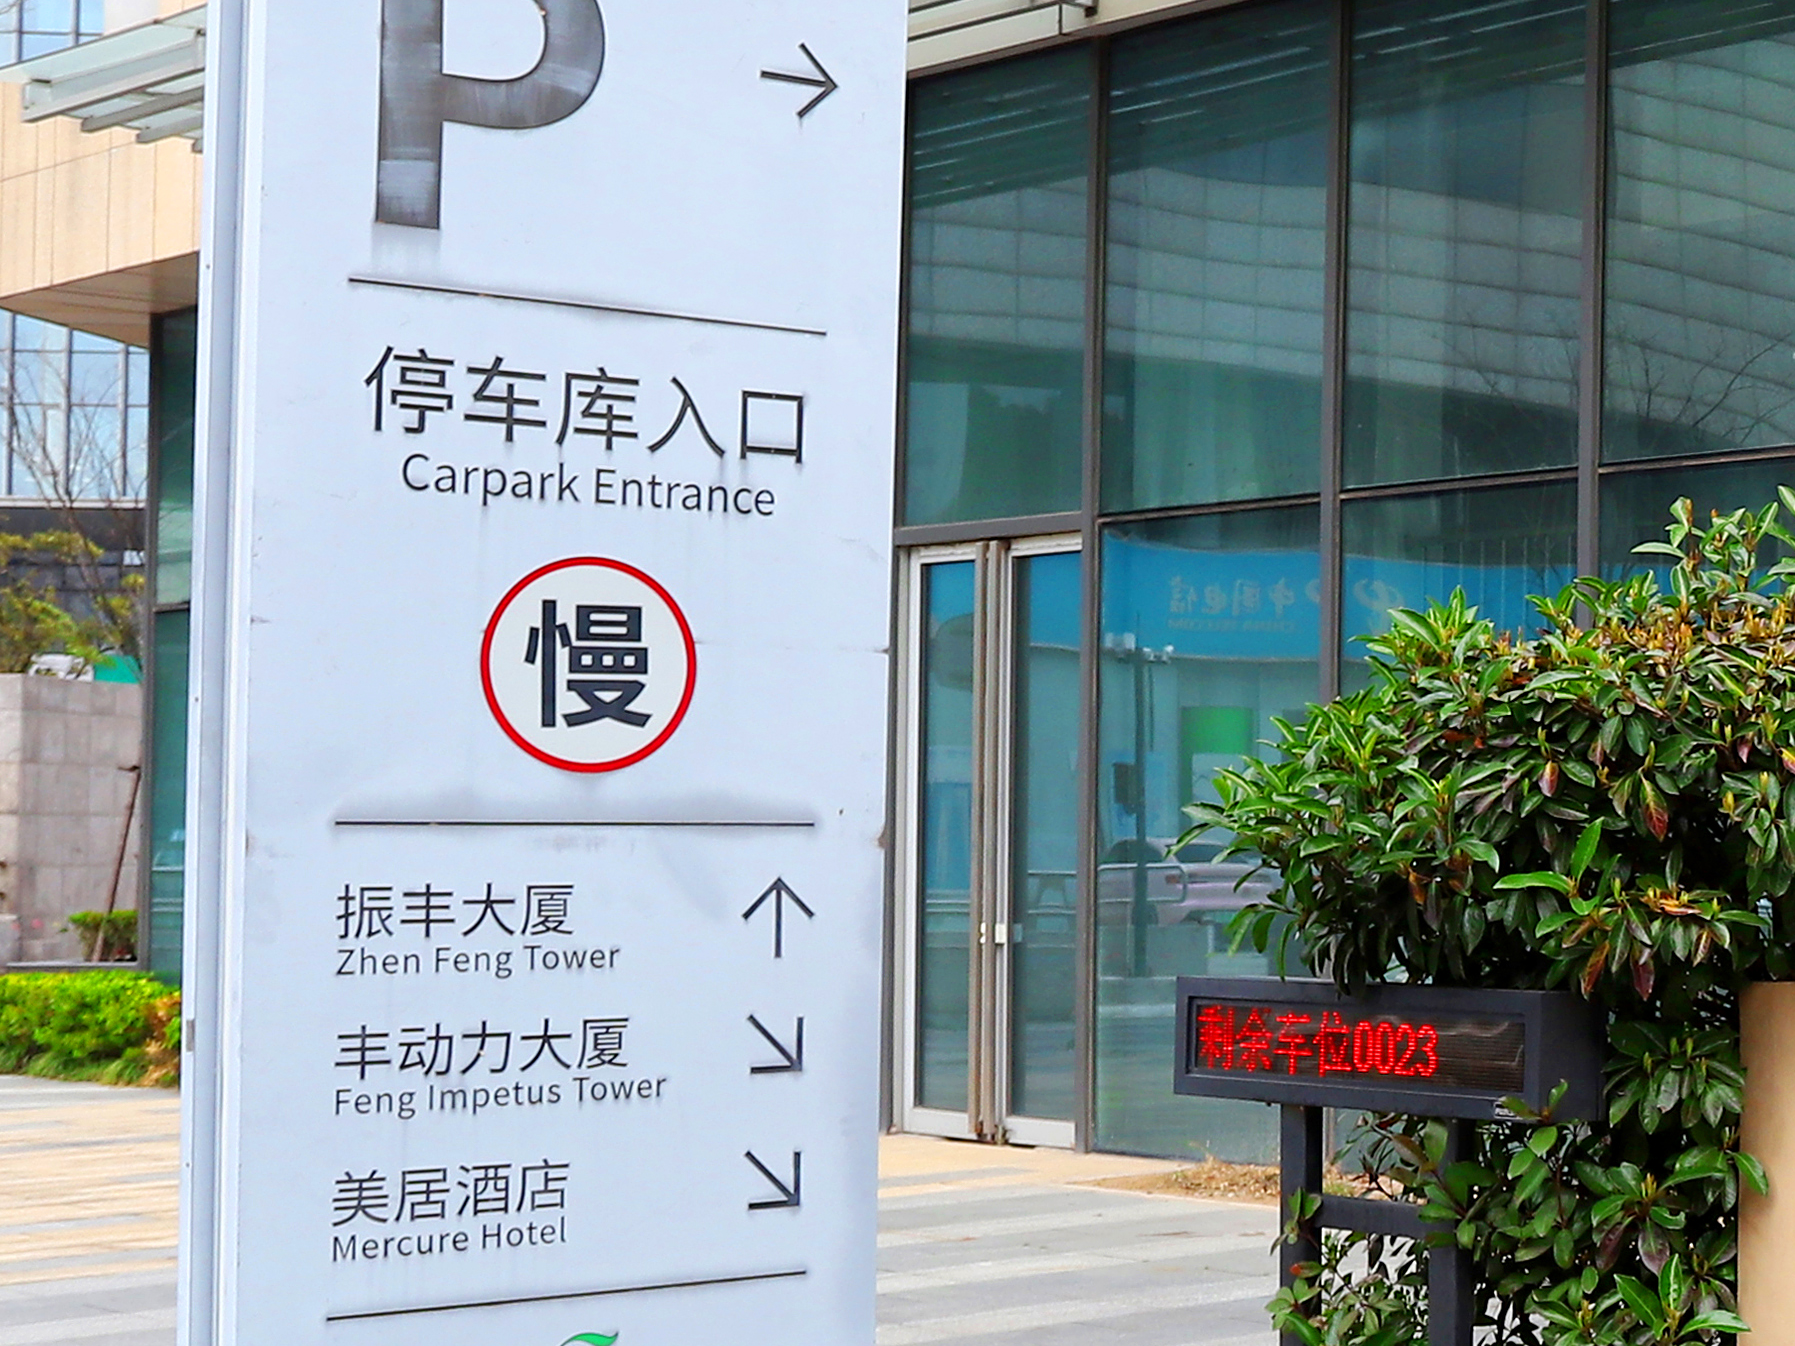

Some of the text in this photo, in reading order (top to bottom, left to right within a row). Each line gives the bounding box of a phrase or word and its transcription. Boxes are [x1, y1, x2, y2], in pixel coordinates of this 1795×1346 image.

[364, 344, 805, 465] 停车库入口
[400, 452, 777, 518] Carpark Entrance
[523, 599, 654, 729] 慢
[335, 882, 575, 940] 振丰大厦
[335, 944, 621, 979] Zhen Feng Tower
[334, 1017, 630, 1081] 丰动力大厦
[1198, 1005, 1439, 1078] 剩余车位0023
[334, 1075, 668, 1119] Feng Impetus Tower
[331, 1158, 571, 1227] 美居酒店
[331, 1215, 567, 1263] Mercure Hotel
